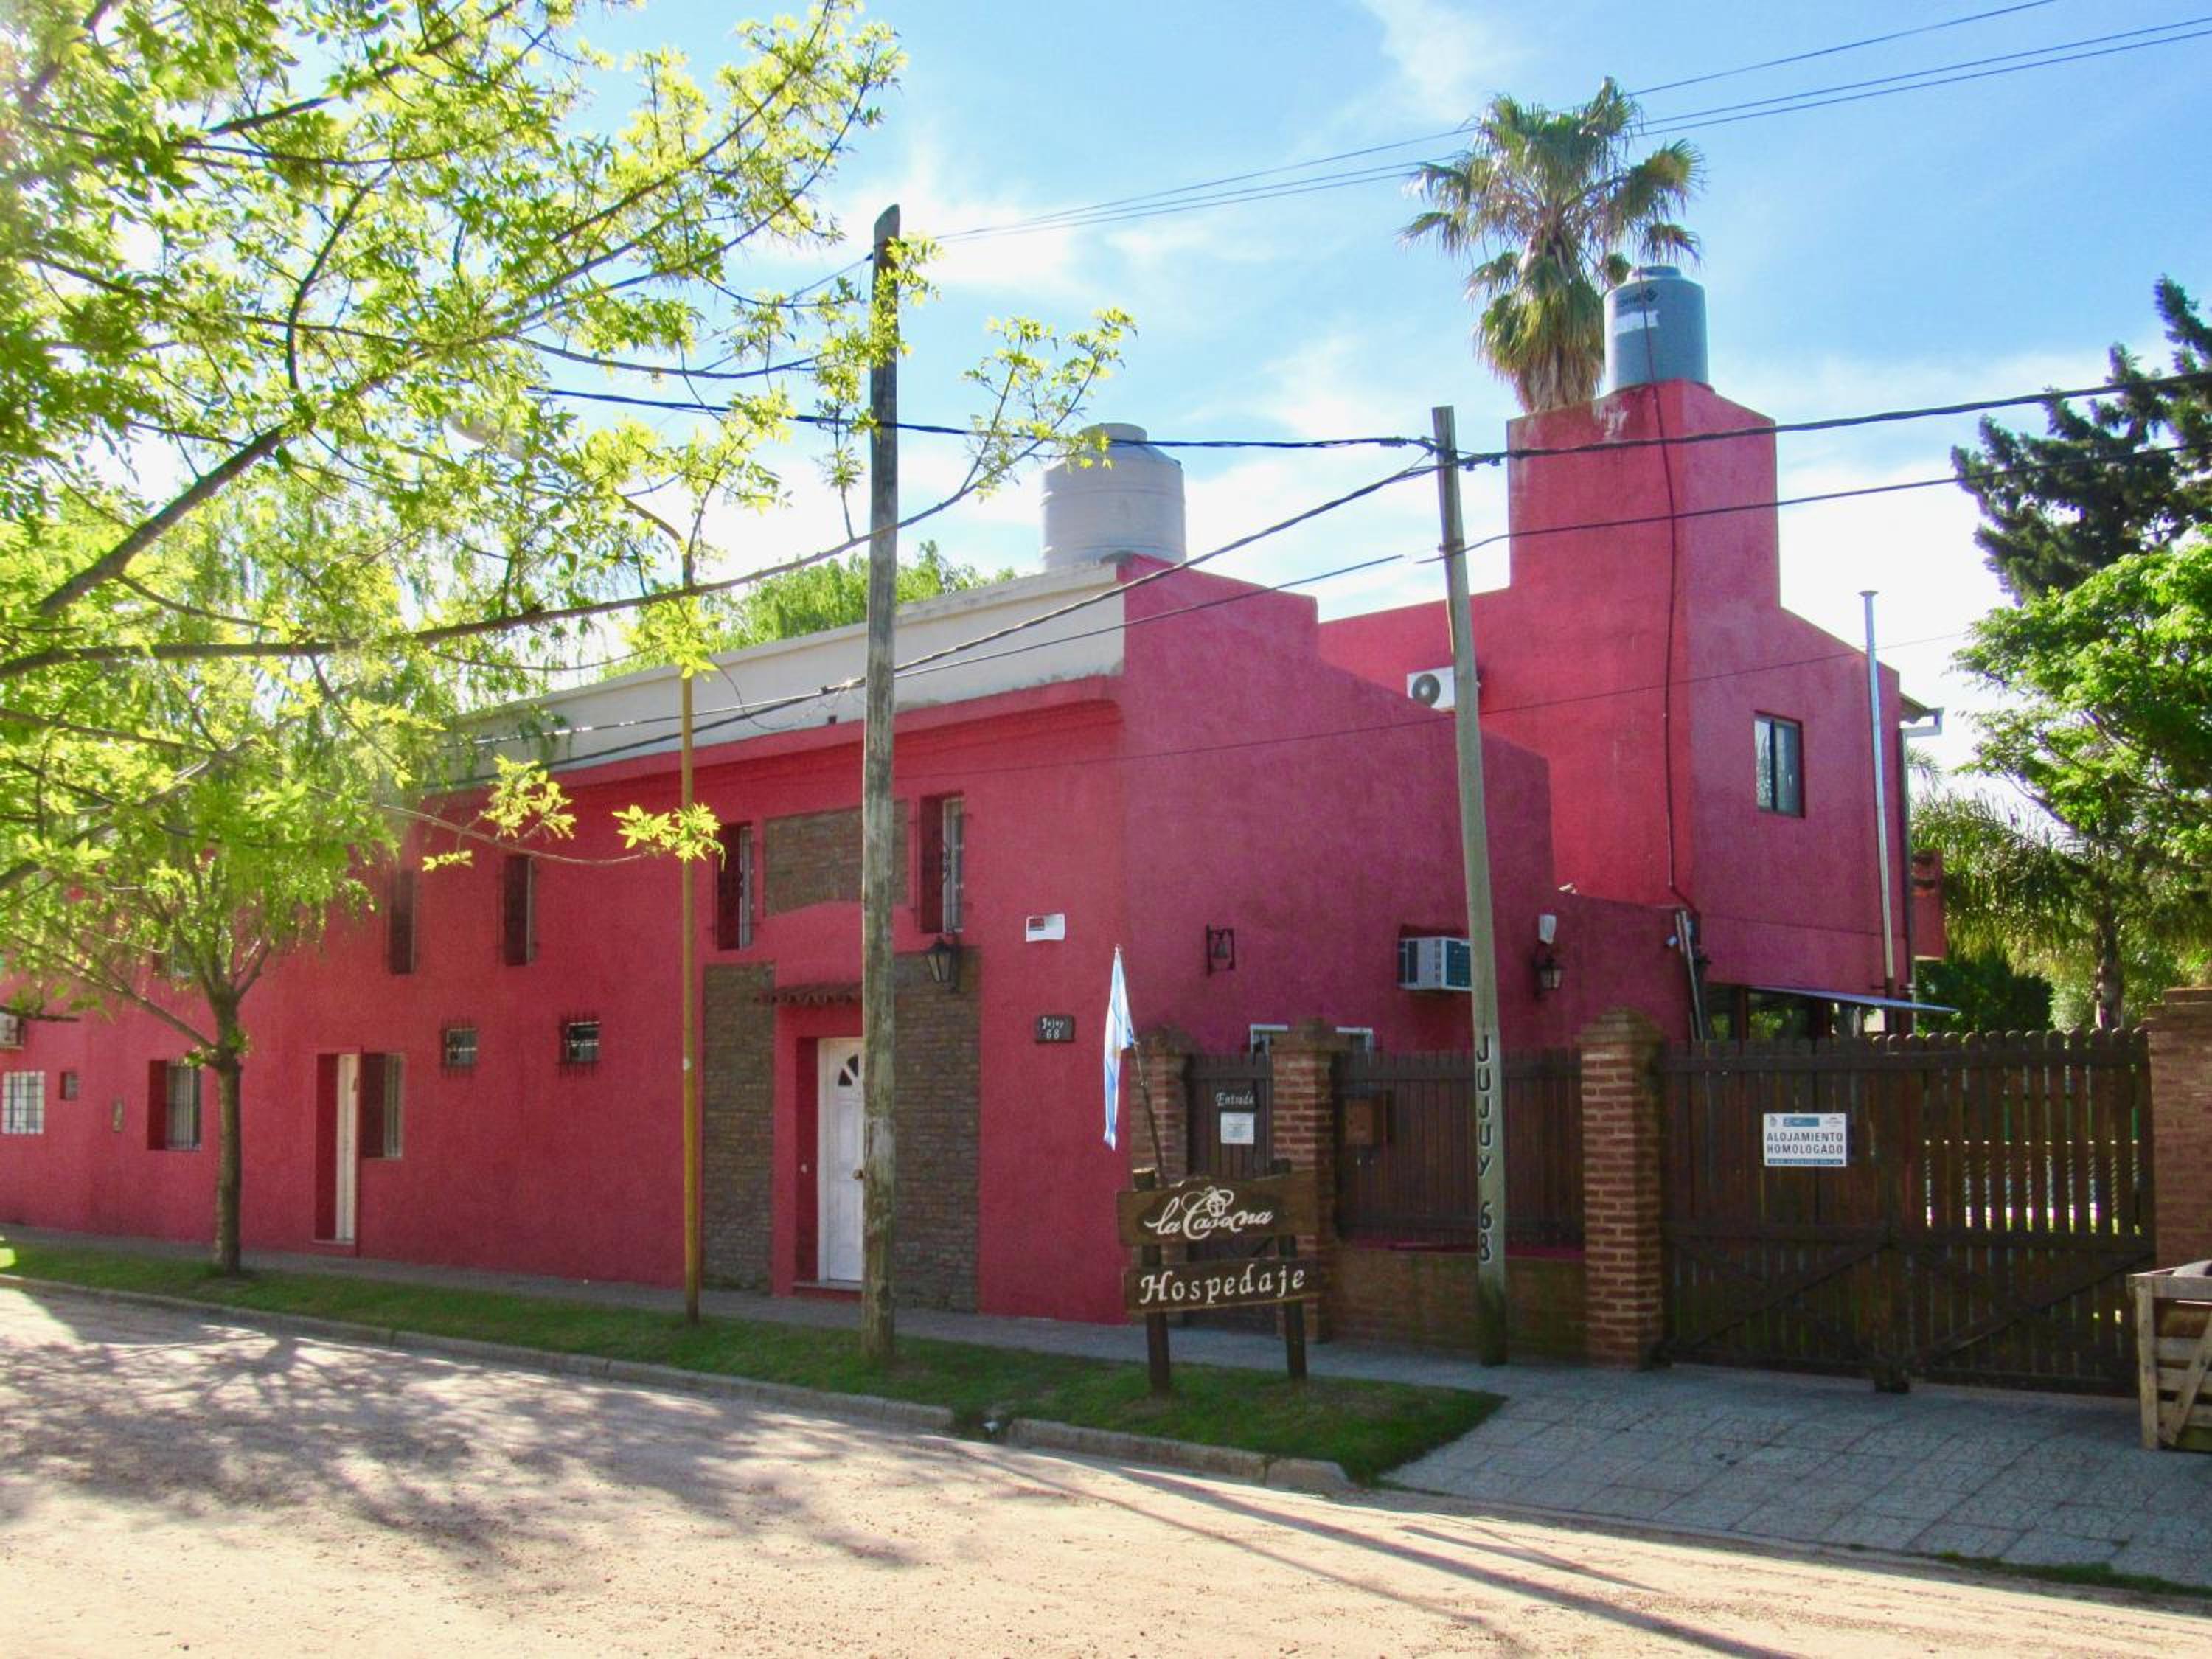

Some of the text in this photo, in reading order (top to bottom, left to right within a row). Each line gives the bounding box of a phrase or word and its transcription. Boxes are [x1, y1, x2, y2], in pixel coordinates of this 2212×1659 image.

[1046, 1029, 1060, 1039] 68
[1767, 1132, 1843, 1142] ALOJAMIENTO
[1767, 1144, 1843, 1154] HOMOLOGADO
[1478, 1200, 1493, 1264] 68
[1139, 1263, 1305, 1305] Hospedaje
